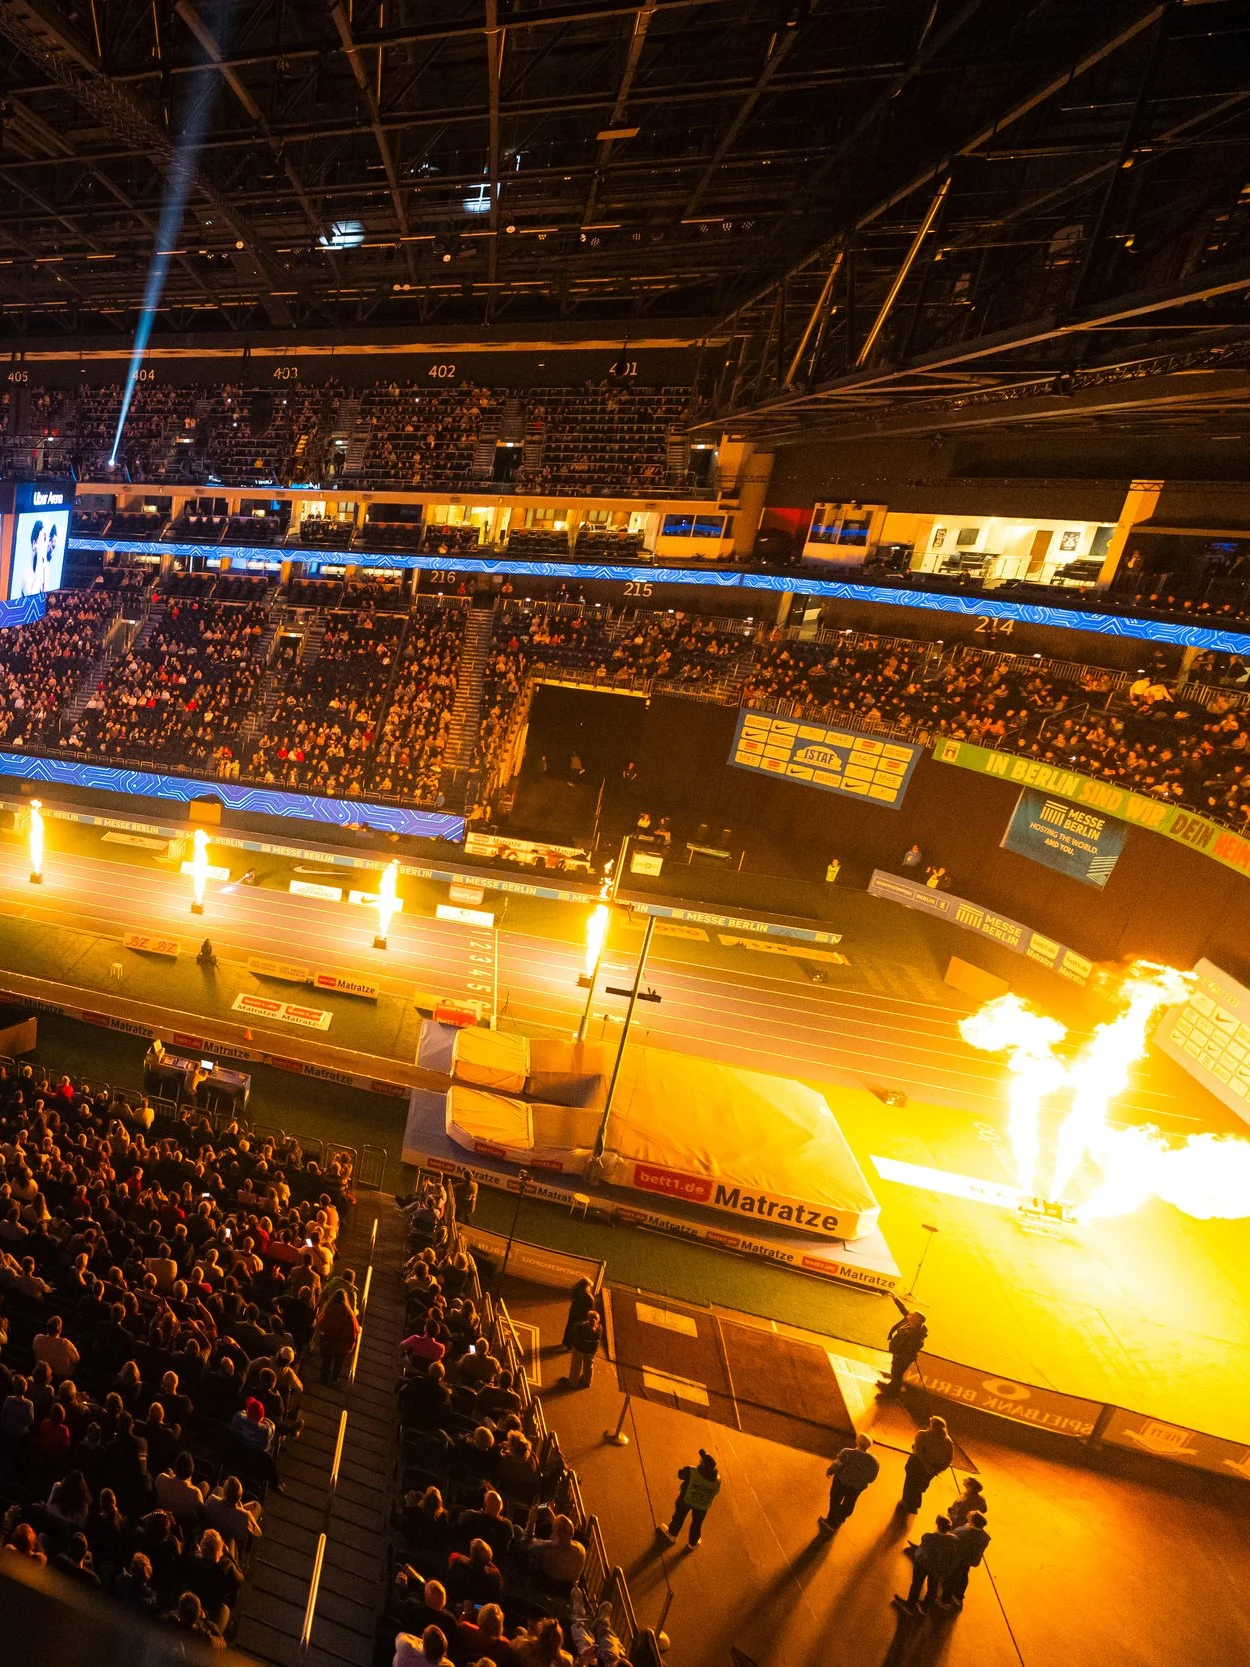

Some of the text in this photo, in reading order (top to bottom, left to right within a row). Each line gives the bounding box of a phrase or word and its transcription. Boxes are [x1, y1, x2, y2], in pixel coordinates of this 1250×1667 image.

[8, 370, 29, 382] 405
[132, 369, 155, 381] 404
[273, 367, 298, 379] 403
[428, 364, 455, 378] 402
[430, 571, 456, 584] 216
[623, 582, 652, 598] 215
[975, 616, 1014, 637] 214
[804, 748, 835, 765] ISTAF
[986, 753, 1006, 775] IN
[1010, 758, 1080, 797] BERLIN
[1080, 781, 1123, 812] SIND
[1125, 796, 1168, 828] WIR
[1170, 813, 1215, 849] DEIN
[54, 811, 78, 822] BERLIN
[1068, 808, 1106, 831] MESSE
[104, 819, 159, 835] MESSE BERLIN
[1030, 822, 1059, 839] HOSTING
[1059, 832, 1073, 844] THE
[1064, 819, 1101, 841] BERLIN
[215, 838, 244, 849] BERLIN
[1044, 837, 1060, 850] AND
[272, 846, 334, 863] MESSE BERLIN
[400, 867, 433, 879] BERLIN
[465, 877, 500, 889] MESSE
[502, 882, 537, 895] BERLIN
[686, 912, 768, 933] MESSE BERLIN
[985, 914, 1023, 937] MESSE
[982, 925, 1020, 947] BERLIN
[469, 941, 493, 951] 2
[469, 954, 493, 963] 3
[468, 968, 492, 977] 4
[337, 979, 376, 995] Matratze
[466, 982, 492, 993] 5
[237, 1004, 278, 1018] Matratze
[110, 1020, 154, 1037] Matratze
[203, 1041, 250, 1059] Matratze
[304, 1065, 354, 1085] Matratze
[640, 1171, 840, 1232] bett1.de Matratze
[647, 1215, 699, 1236] Matratze
[741, 1240, 795, 1263] Matratze
[803, 1258, 897, 1289] bett1.de Matratze
